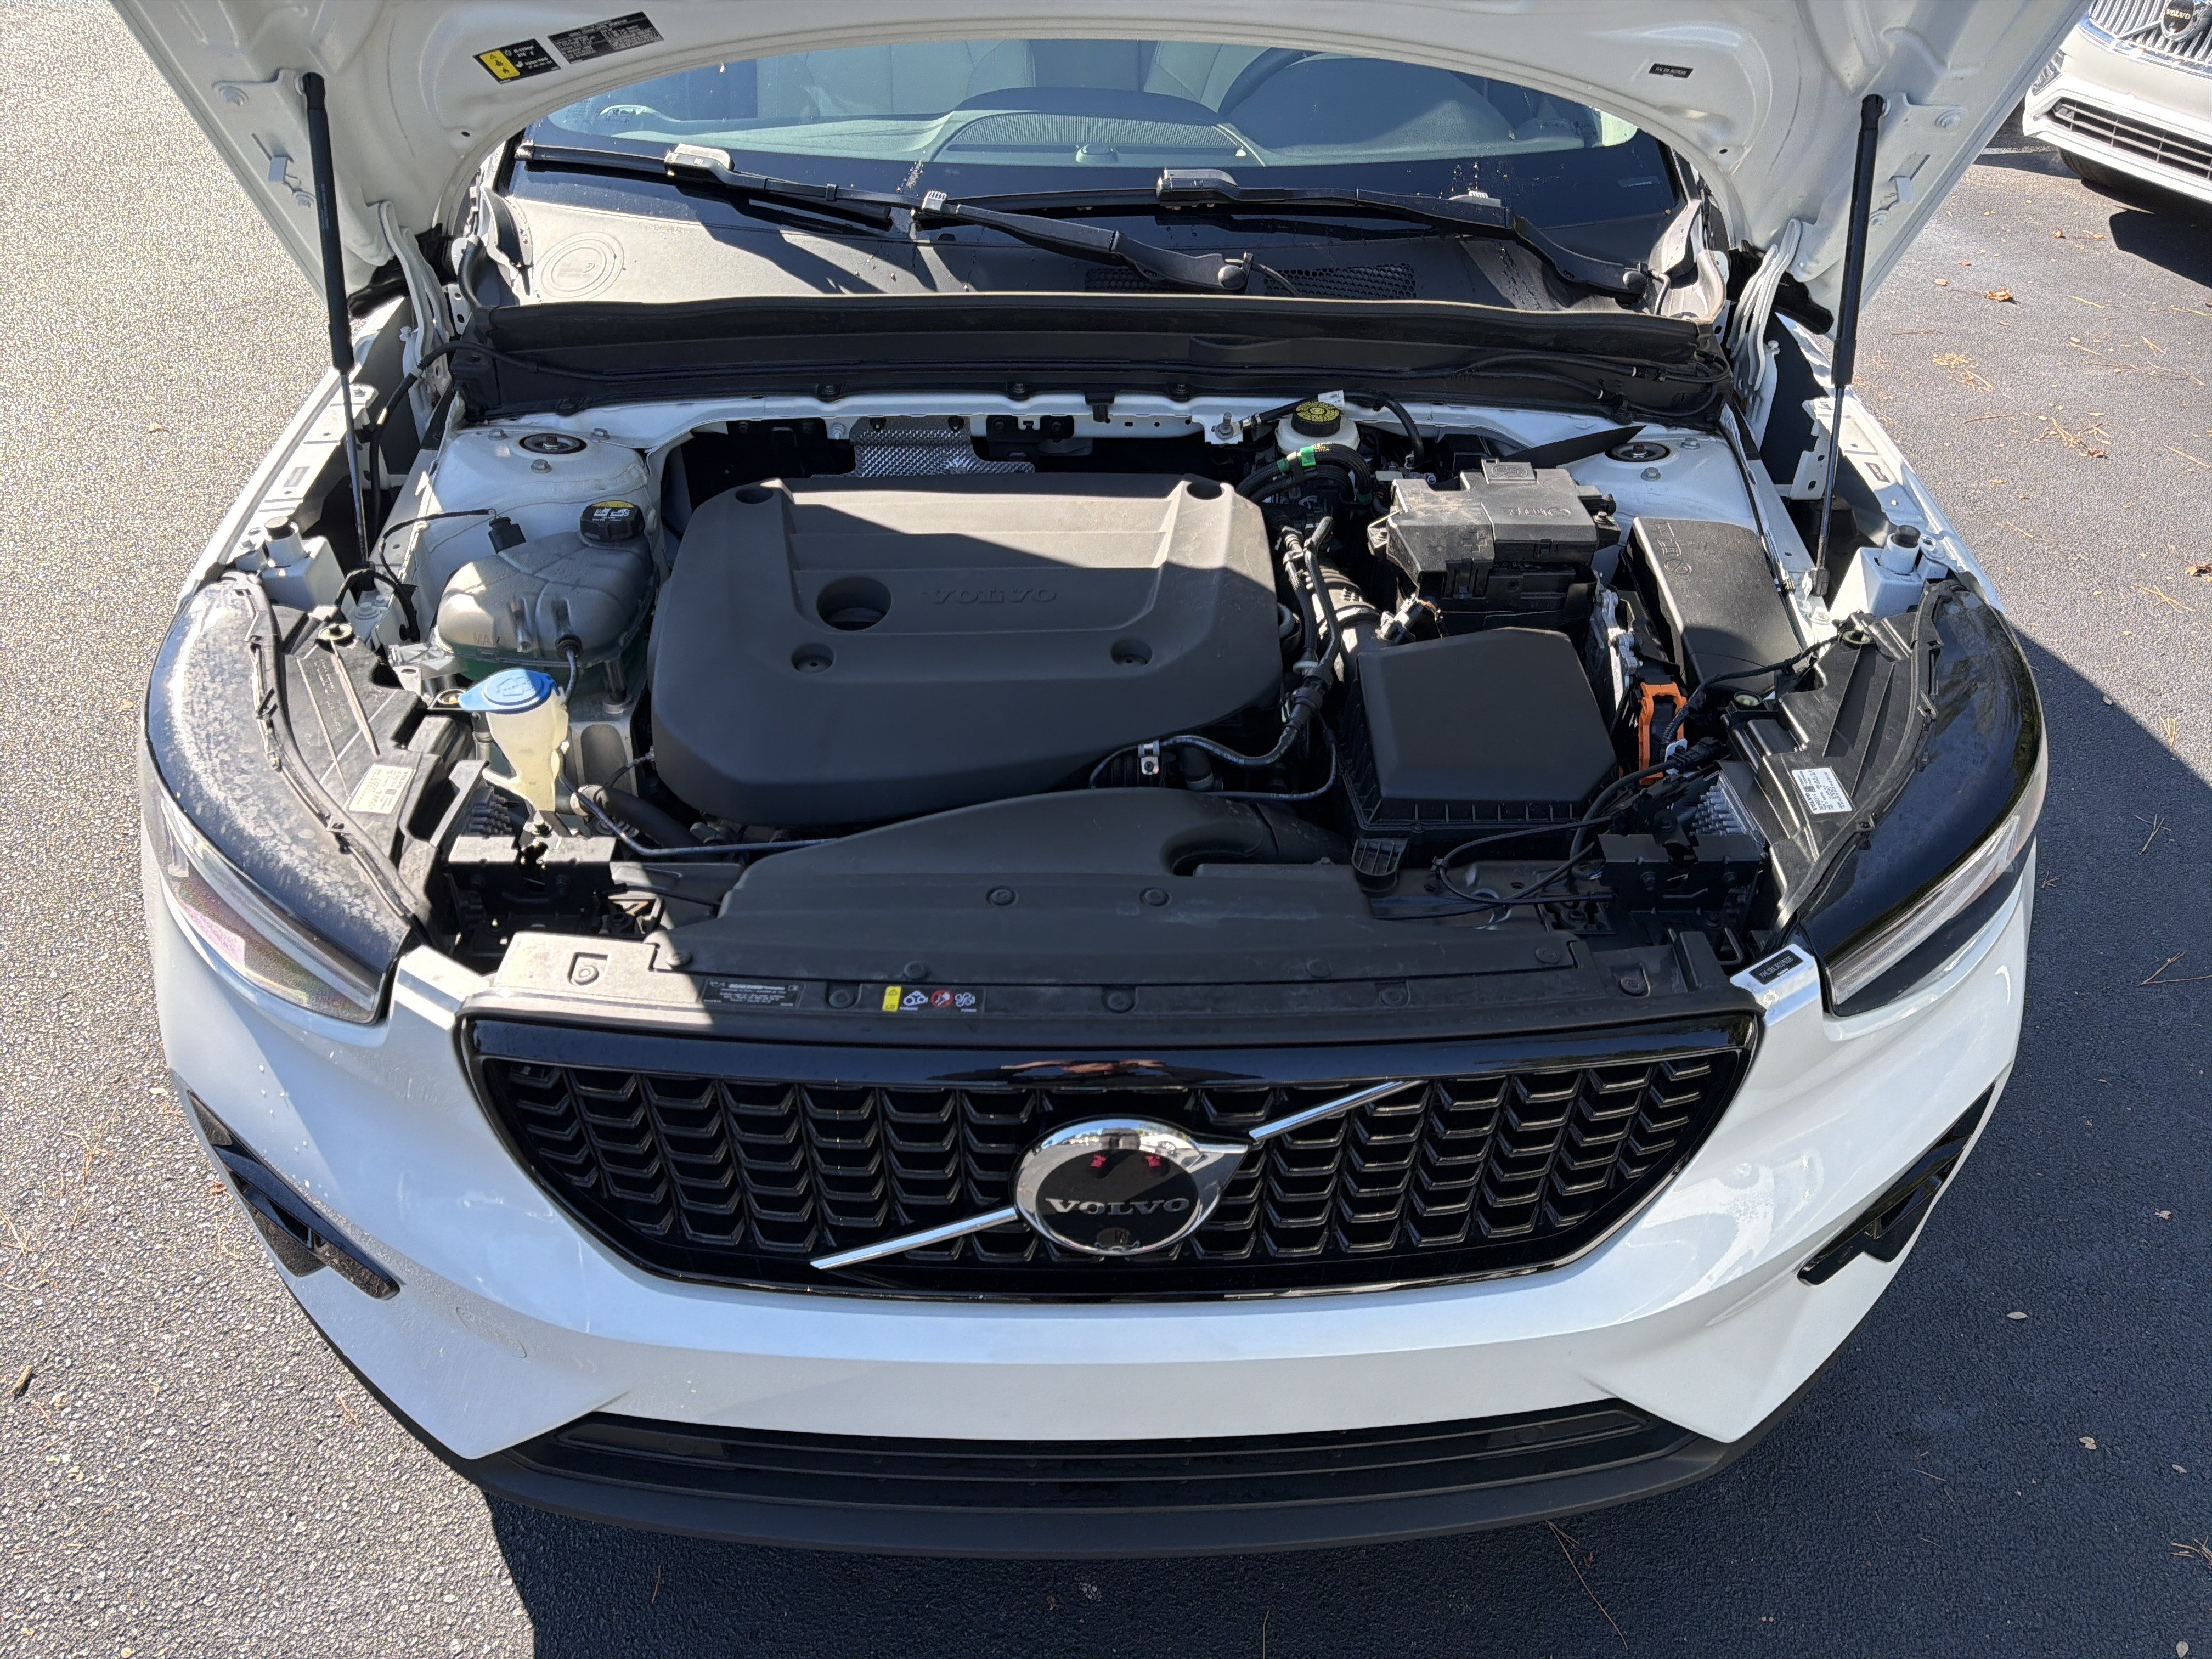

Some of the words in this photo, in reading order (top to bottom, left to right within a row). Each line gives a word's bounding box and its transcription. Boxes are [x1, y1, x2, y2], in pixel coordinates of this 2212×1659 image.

[2166, 8, 2191, 20] VOLVO
[933, 588, 1057, 605] VOLVO
[1805, 793, 1818, 811] VOLVO
[1045, 1197, 1190, 1216] VOLVO
